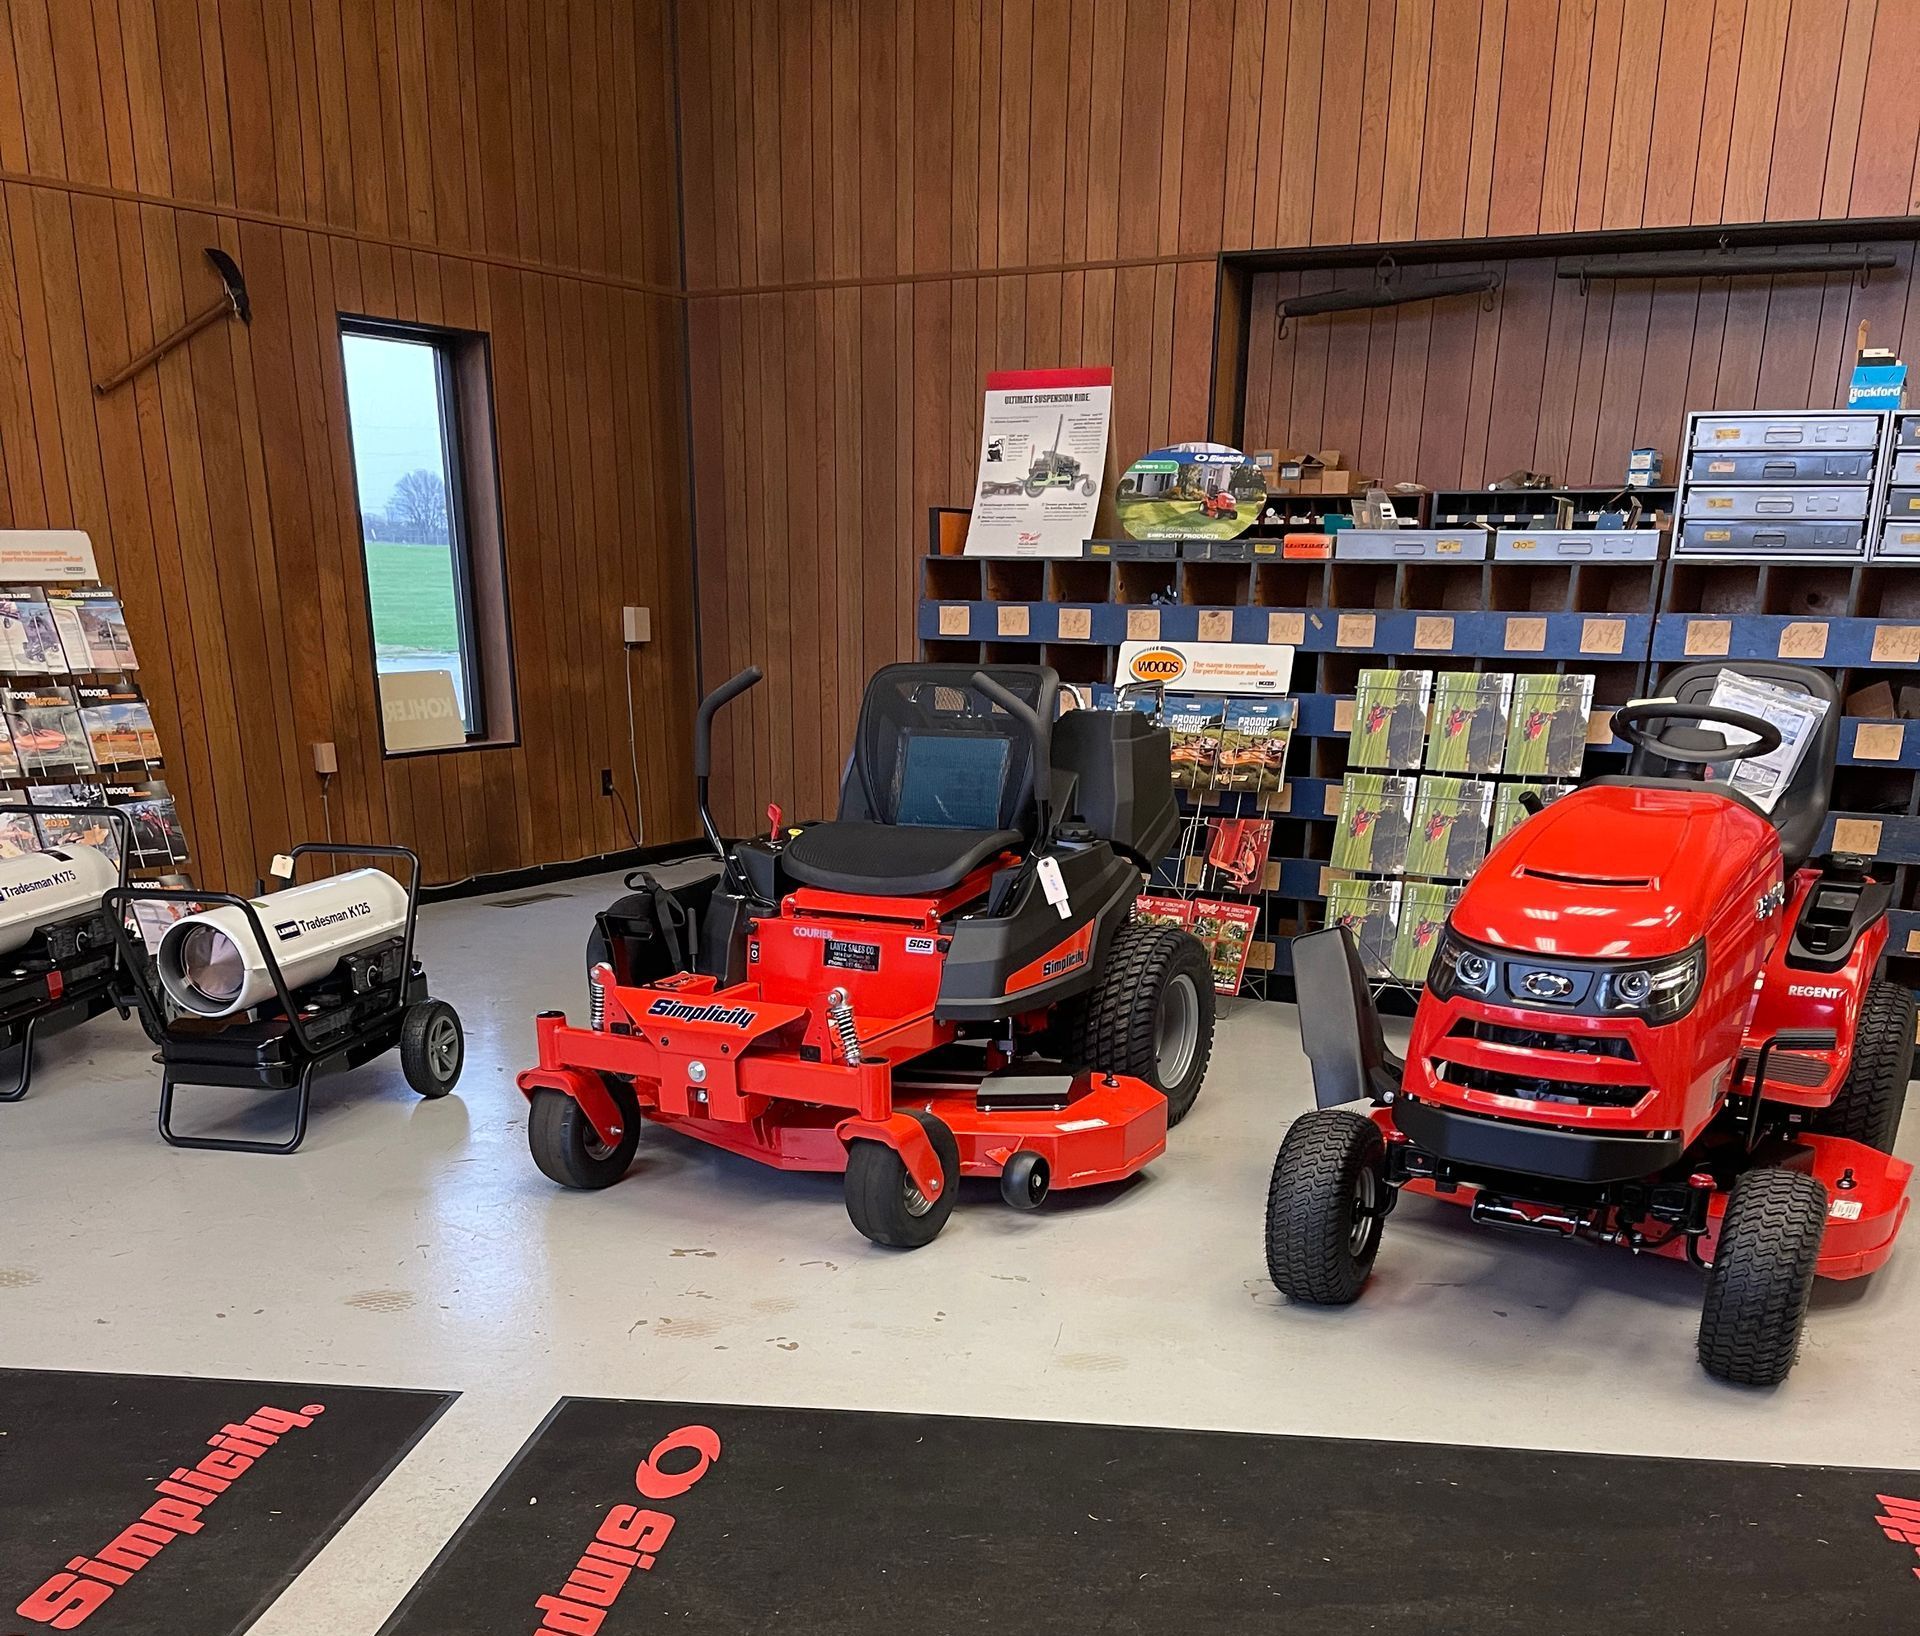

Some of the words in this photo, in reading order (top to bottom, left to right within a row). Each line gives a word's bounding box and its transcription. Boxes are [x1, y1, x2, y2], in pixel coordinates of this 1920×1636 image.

[1004, 395, 1034, 405] ULTIMATE
[1034, 393, 1073, 404] SUSPENSION
[1074, 392, 1090, 402] RIDE
[1849, 387, 1901, 399] Rockford
[1208, 454, 1246, 463] Simplicity
[1138, 660, 1179, 673] WOODS
[1233, 661, 1266, 669] remember
[1202, 668, 1245, 676] performance
[5, 691, 37, 699] WOODS
[79, 689, 109, 697] WOODS
[1171, 714, 1211, 726] PRODUCT
[1238, 716, 1278, 728] PRODUCT
[1177, 723, 1202, 733] GUIDE
[1243, 726, 1269, 736] GUIDE
[105, 786, 134, 795] WOODS
[44, 819, 70, 828] 2020
[3, 876, 54, 898] Tradesman
[52, 870, 77, 886] K175
[132, 881, 161, 889] WOODS
[298, 910, 349, 932] Tradesman
[347, 902, 371, 918] K125
[793, 926, 834, 939] COURIER
[829, 942, 847, 951] LANTZ
[847, 943, 866, 954] SALES
[908, 939, 932, 949] SCS
[1042, 949, 1085, 976] Simplicity
[1787, 984, 1840, 999] REGENT
[647, 999, 757, 1029] Simplicity
[17, 1405, 316, 1630] Simplicity
[533, 1504, 676, 1636] Simp
